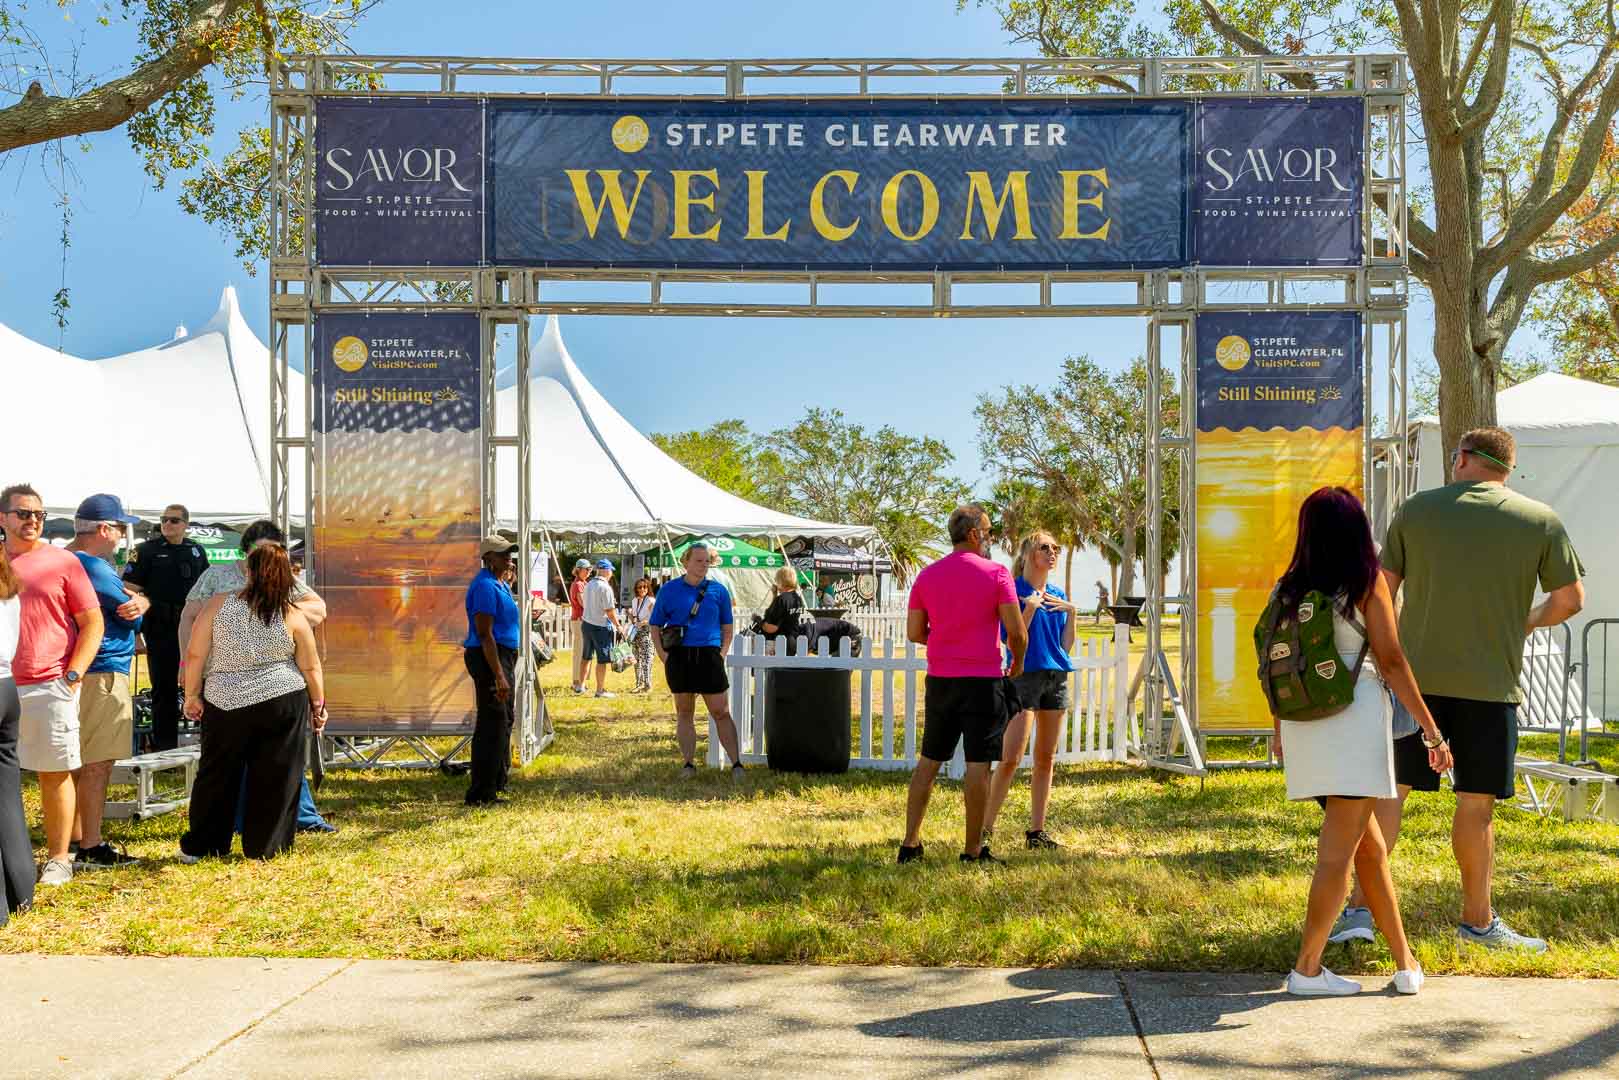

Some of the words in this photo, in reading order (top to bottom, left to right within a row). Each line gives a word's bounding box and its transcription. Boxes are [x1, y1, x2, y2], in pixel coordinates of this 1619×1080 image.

[666, 123, 804, 146] ST.PETE
[825, 123, 1067, 146] CLEARWATER
[326, 148, 473, 191] SAVOR
[1206, 148, 1353, 191] SAVOR
[366, 195, 433, 205] ST.PETE
[1246, 196, 1312, 205] ST.PETE
[564, 168, 1112, 243] WELCOME
[325, 209, 358, 217] FOOD
[1204, 209, 1237, 217] FOOD
[1294, 209, 1353, 217] FESTIVAL
[371, 338, 414, 347] ST.PETE
[1254, 337, 1297, 346] ST.PETE
[371, 361, 438, 369] VisitSPC.com
[1254, 359, 1321, 368] VisitSPC.com
[335, 386, 367, 402] Still
[371, 386, 433, 404] Shining
[1218, 385, 1250, 401] Still
[1254, 384, 1317, 404] Shining
